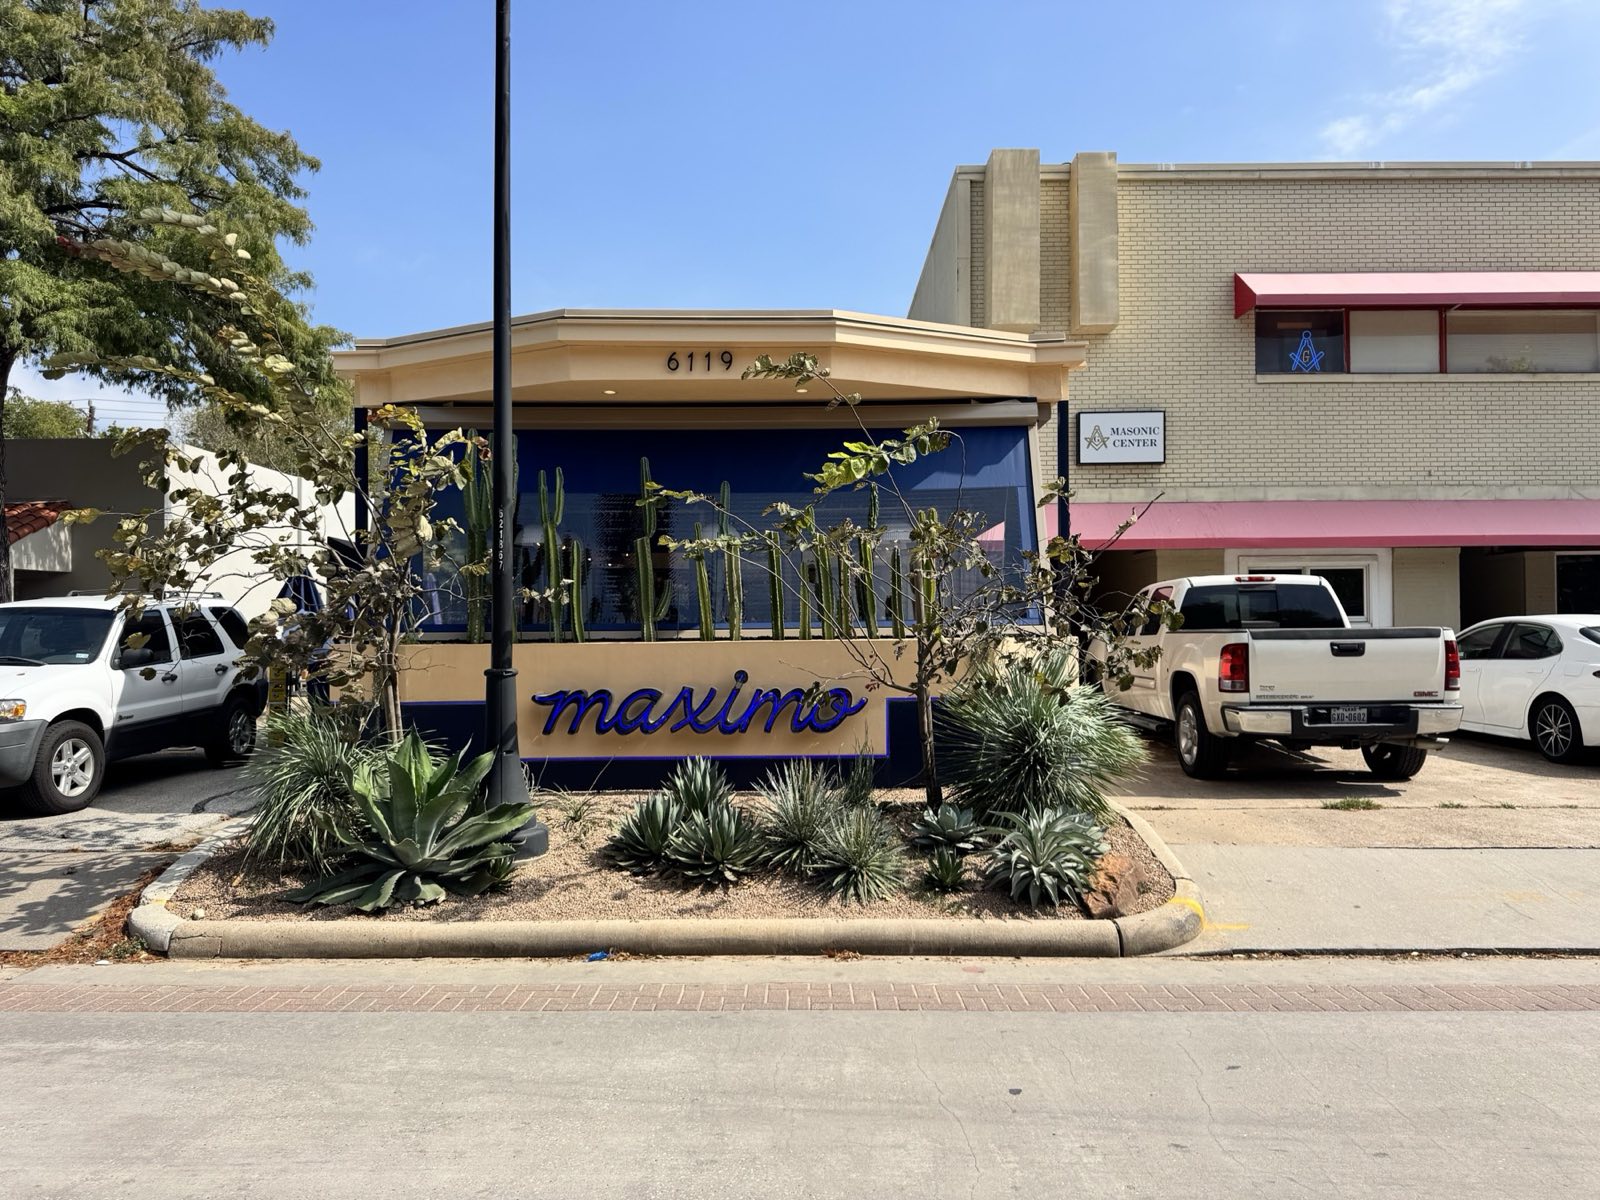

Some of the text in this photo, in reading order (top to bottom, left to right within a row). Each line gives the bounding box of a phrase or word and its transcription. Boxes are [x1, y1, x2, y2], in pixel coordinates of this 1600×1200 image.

[667, 350, 733, 372] 6119
[1110, 426, 1160, 436] MASONIC
[1112, 438, 1157, 448] CENTER
[531, 670, 868, 735] maximo
